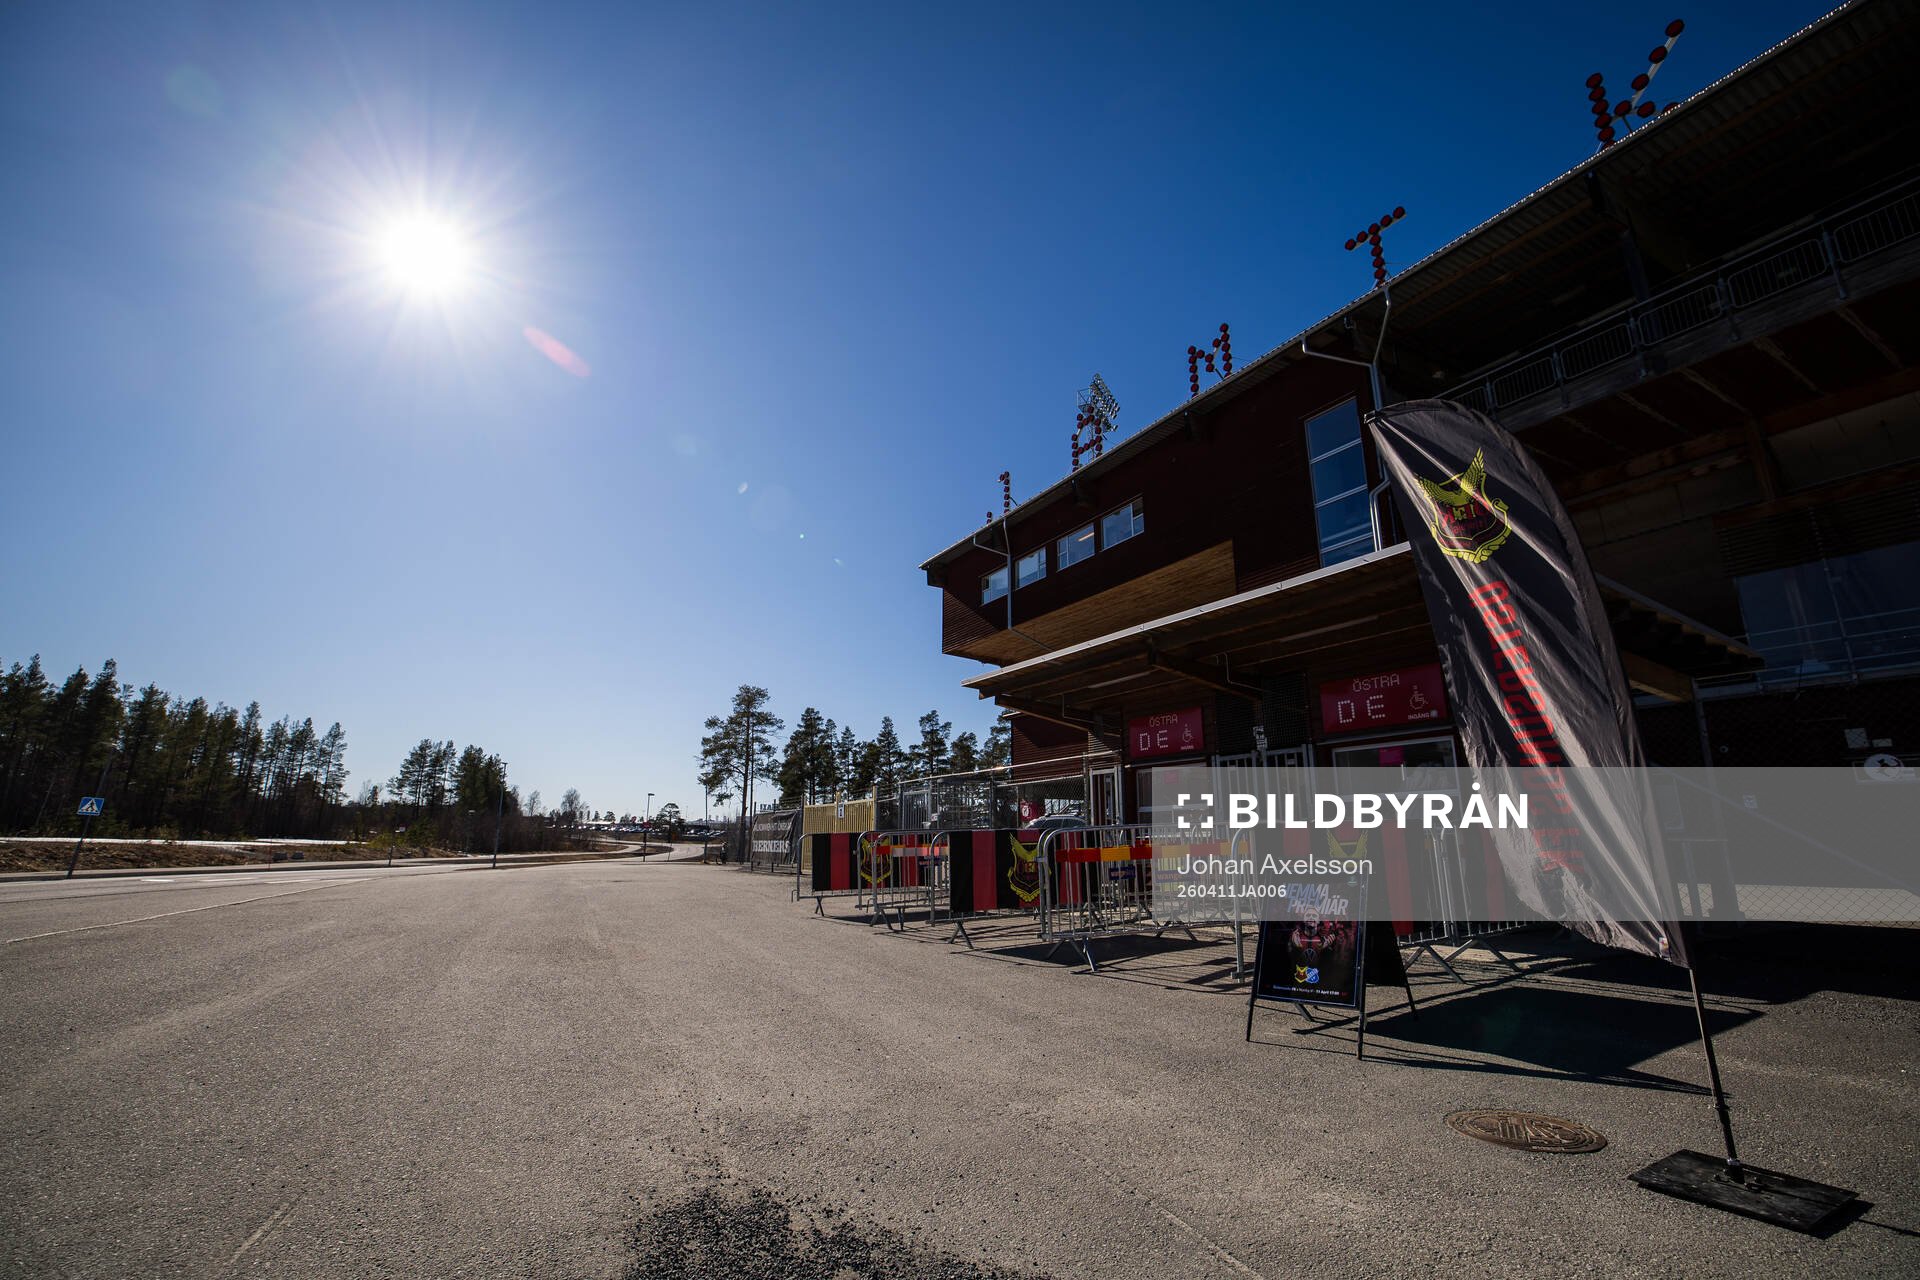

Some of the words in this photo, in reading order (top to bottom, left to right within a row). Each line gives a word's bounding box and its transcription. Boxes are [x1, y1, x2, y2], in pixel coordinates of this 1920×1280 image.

[1352, 673, 1401, 692] ÖSTRA
[1149, 713, 1179, 727] ÖSTRA
[1287, 894, 1350, 915] PREMIÄR
